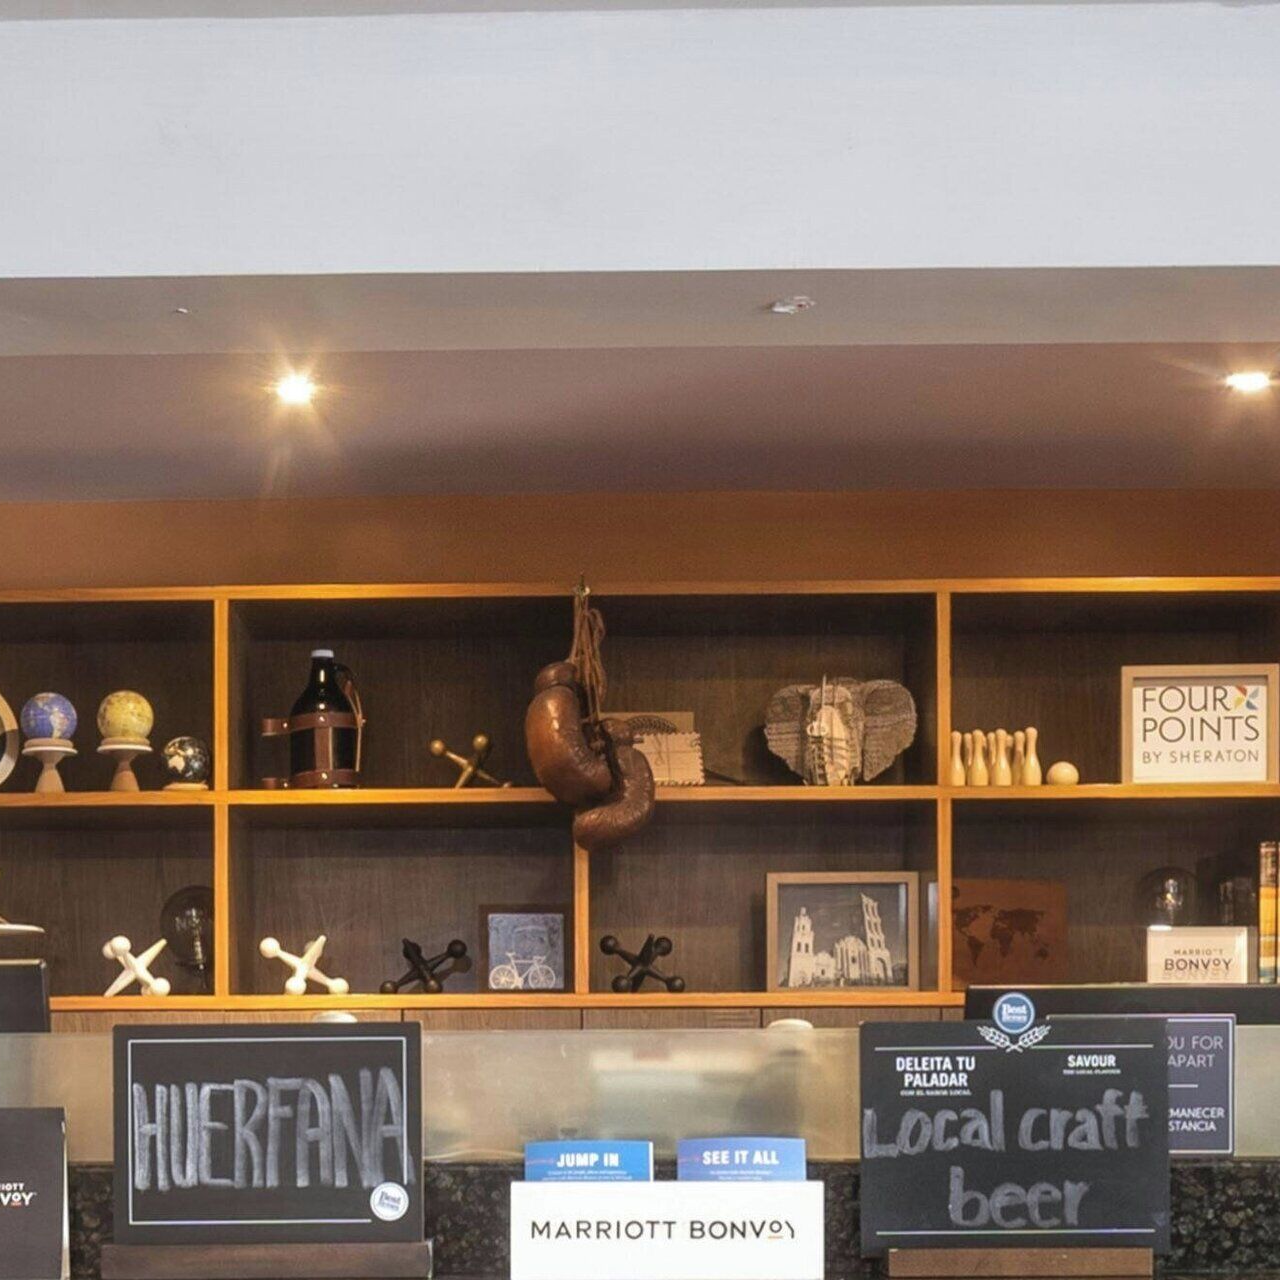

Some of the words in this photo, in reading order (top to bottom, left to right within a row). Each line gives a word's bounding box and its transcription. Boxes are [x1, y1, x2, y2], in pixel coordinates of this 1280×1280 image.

[1142, 685, 1231, 713] FOUR
[1142, 715, 1260, 743] POINTS
[1142, 751, 1163, 764] BY
[1170, 749, 1260, 764] SHERATON
[1164, 958, 1232, 971] BONVOY
[1191, 1035, 1224, 1050] FOR
[896, 1056, 951, 1071] DELEITA
[956, 1056, 976, 1071] TU
[1067, 1055, 1116, 1067] SAVOUR
[1167, 1054, 1215, 1068] APART
[904, 1072, 968, 1088] PALADAR
[1020, 1088, 1149, 1151] craft
[132, 1066, 416, 1192] HUERFANA
[556, 1153, 598, 1167] JUMP
[603, 1153, 619, 1167] IN
[703, 1151, 730, 1165] SEE
[735, 1151, 749, 1165] IT
[753, 1151, 780, 1165] ALL
[949, 1166, 1090, 1228] beer
[531, 1220, 677, 1240] MARRIOTT
